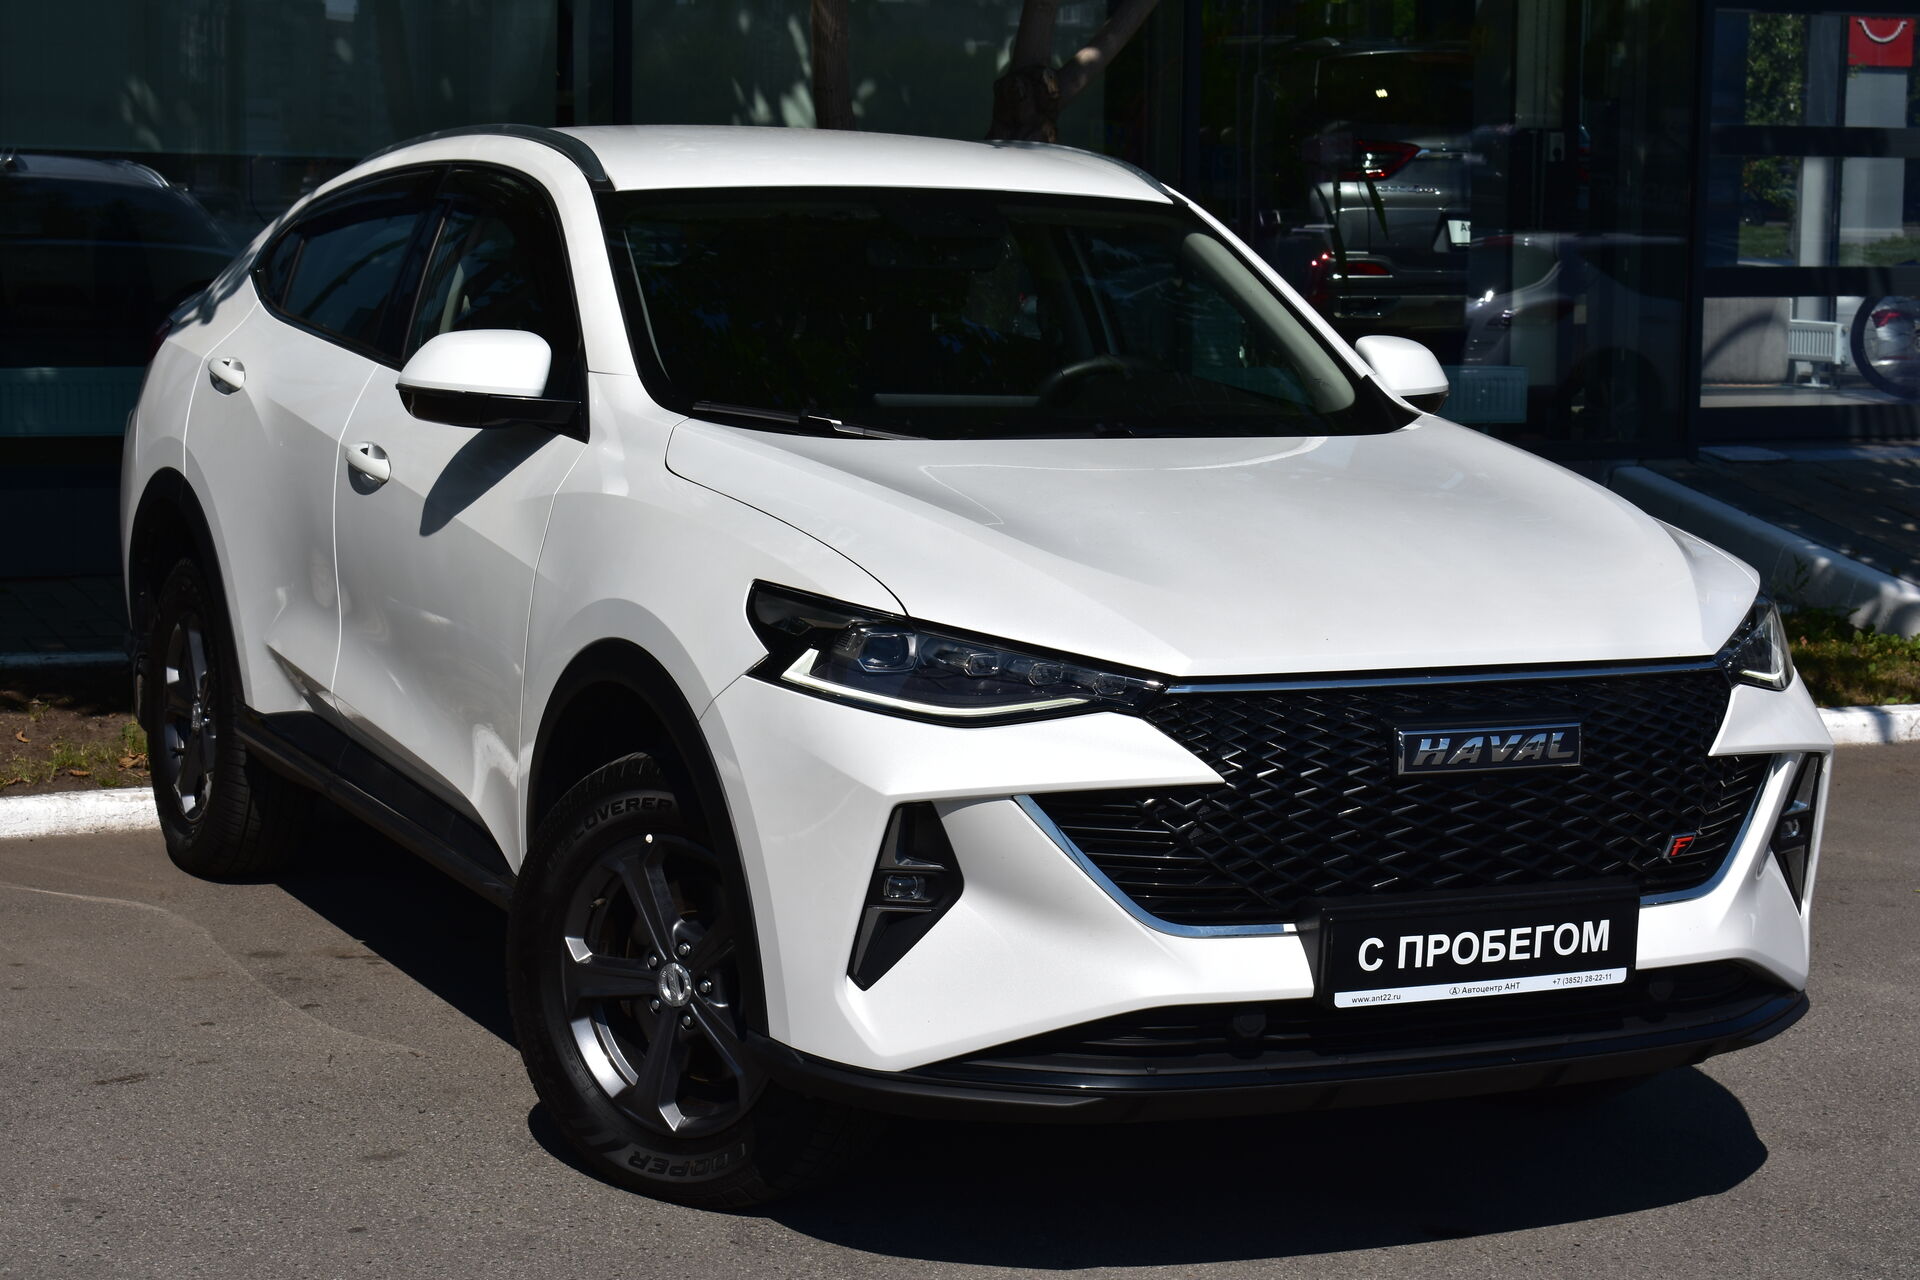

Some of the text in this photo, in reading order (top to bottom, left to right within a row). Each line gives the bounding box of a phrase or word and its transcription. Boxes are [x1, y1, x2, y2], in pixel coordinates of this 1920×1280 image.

[1412, 732, 1575, 766] HAVAL
[1671, 837, 1693, 856] F
[1358, 919, 1611, 972] С ПРОБЕГОМ
[1562, 976, 1584, 986] (3852)
[1584, 973, 1613, 983] 28-22-11
[1461, 985, 1503, 995] Автоцентр
[1504, 982, 1521, 991] АНТ
[1351, 993, 1402, 1004] www.ant22.ru
